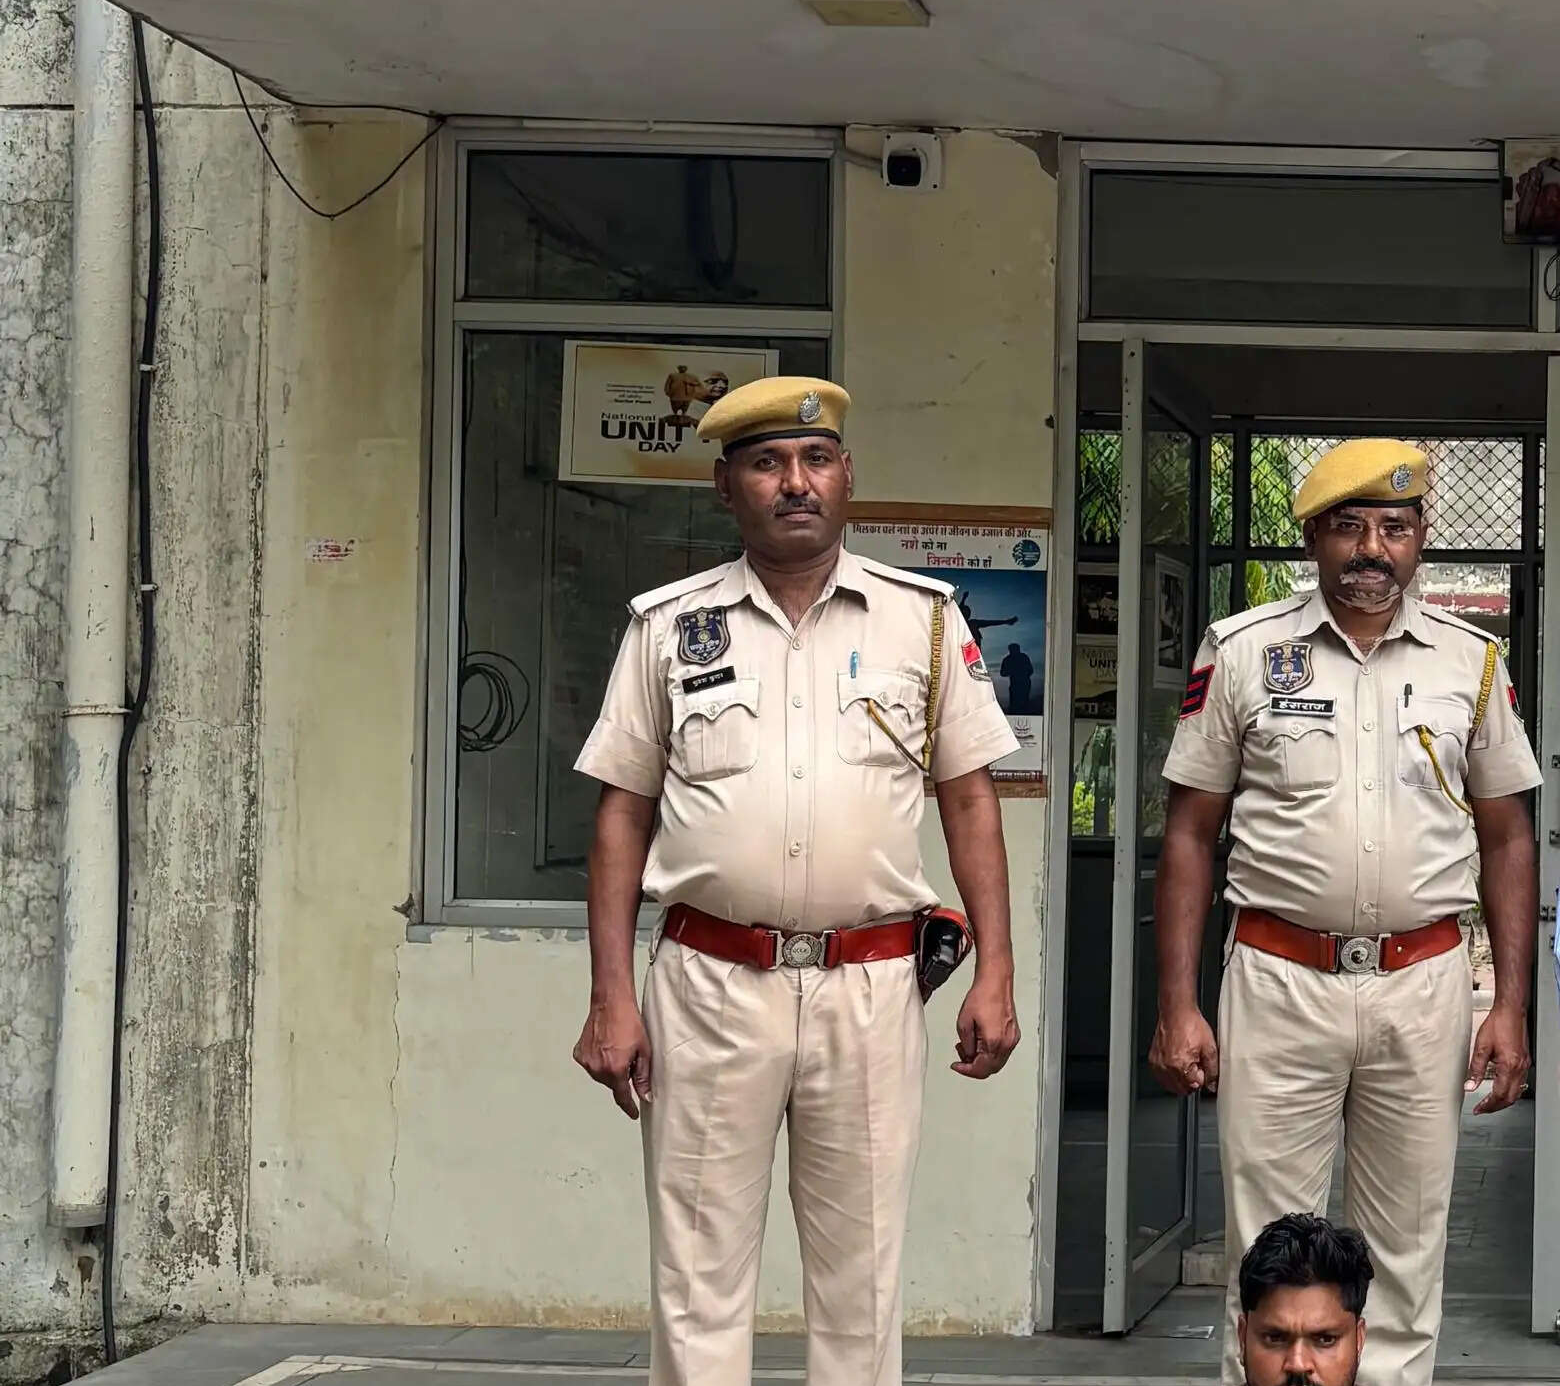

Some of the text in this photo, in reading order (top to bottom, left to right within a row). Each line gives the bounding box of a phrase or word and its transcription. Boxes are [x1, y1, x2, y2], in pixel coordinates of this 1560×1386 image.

[601, 412, 656, 422] National
[639, 441, 681, 453] DAY
[901, 536, 948, 551] नशे को ना
[967, 555, 980, 567] को
